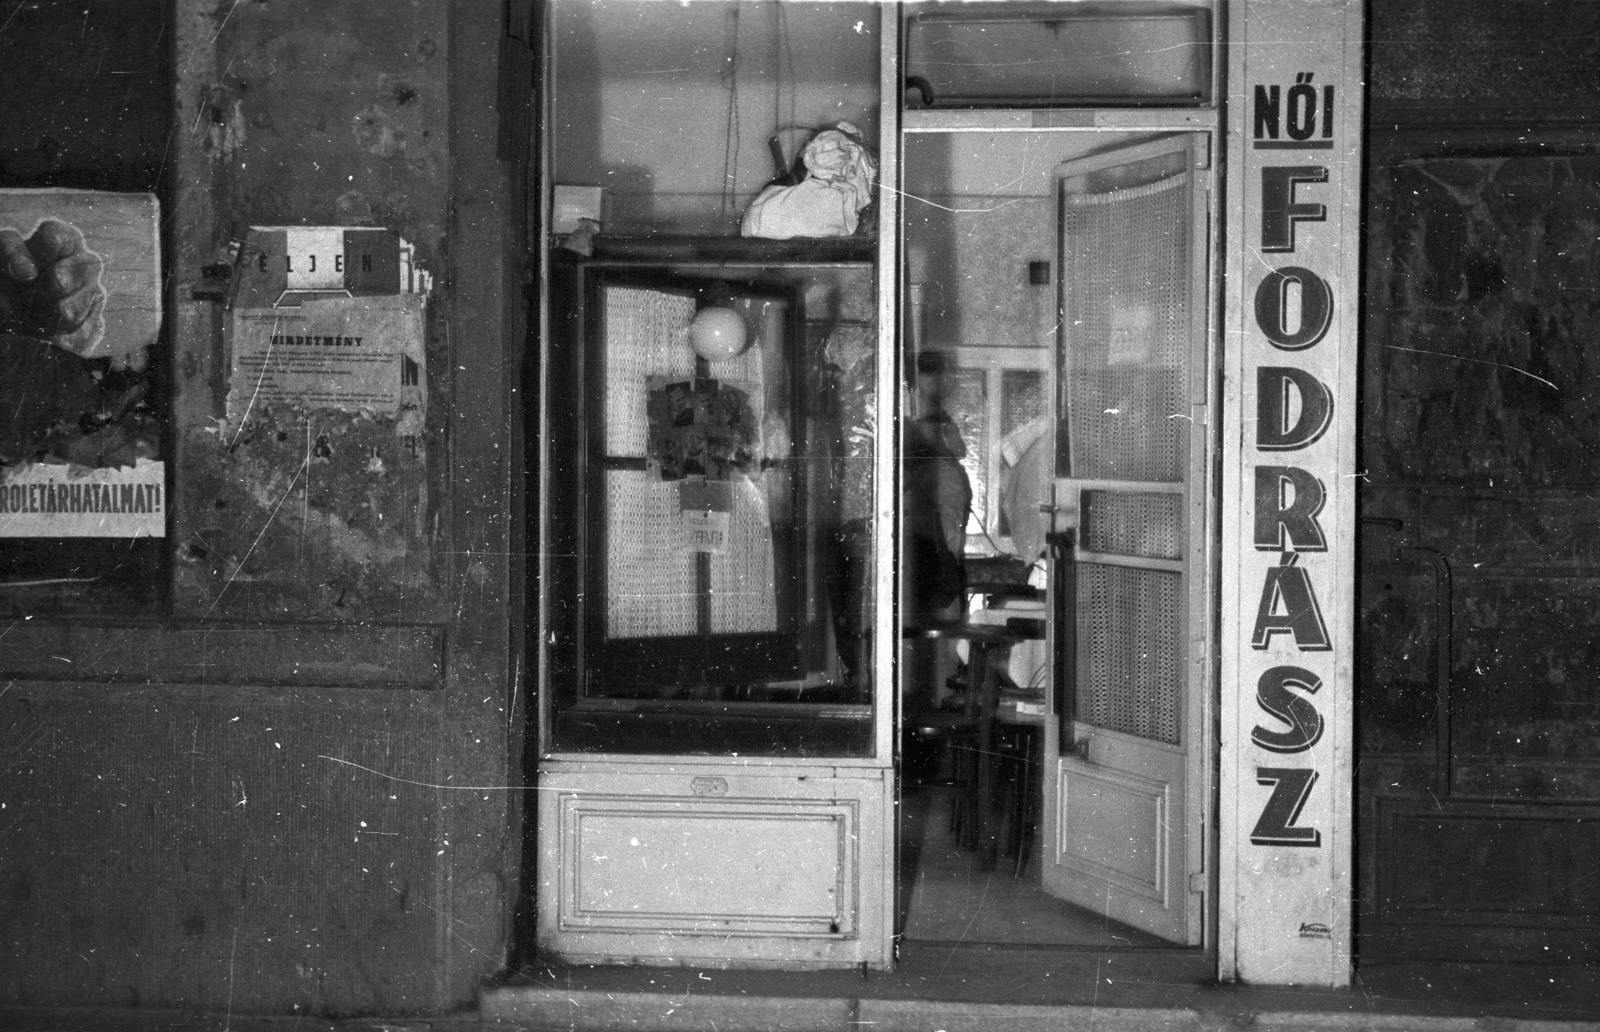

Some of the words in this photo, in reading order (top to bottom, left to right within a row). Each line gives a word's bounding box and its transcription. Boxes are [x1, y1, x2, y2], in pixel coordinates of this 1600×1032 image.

[1254, 72, 1335, 141] NŐI
[270, 334, 363, 346] HIRDETMÉNY
[0, 478, 161, 513] ROLETÁRHATALMAT!
[1250, 165, 1335, 848] FODRÁSZ
